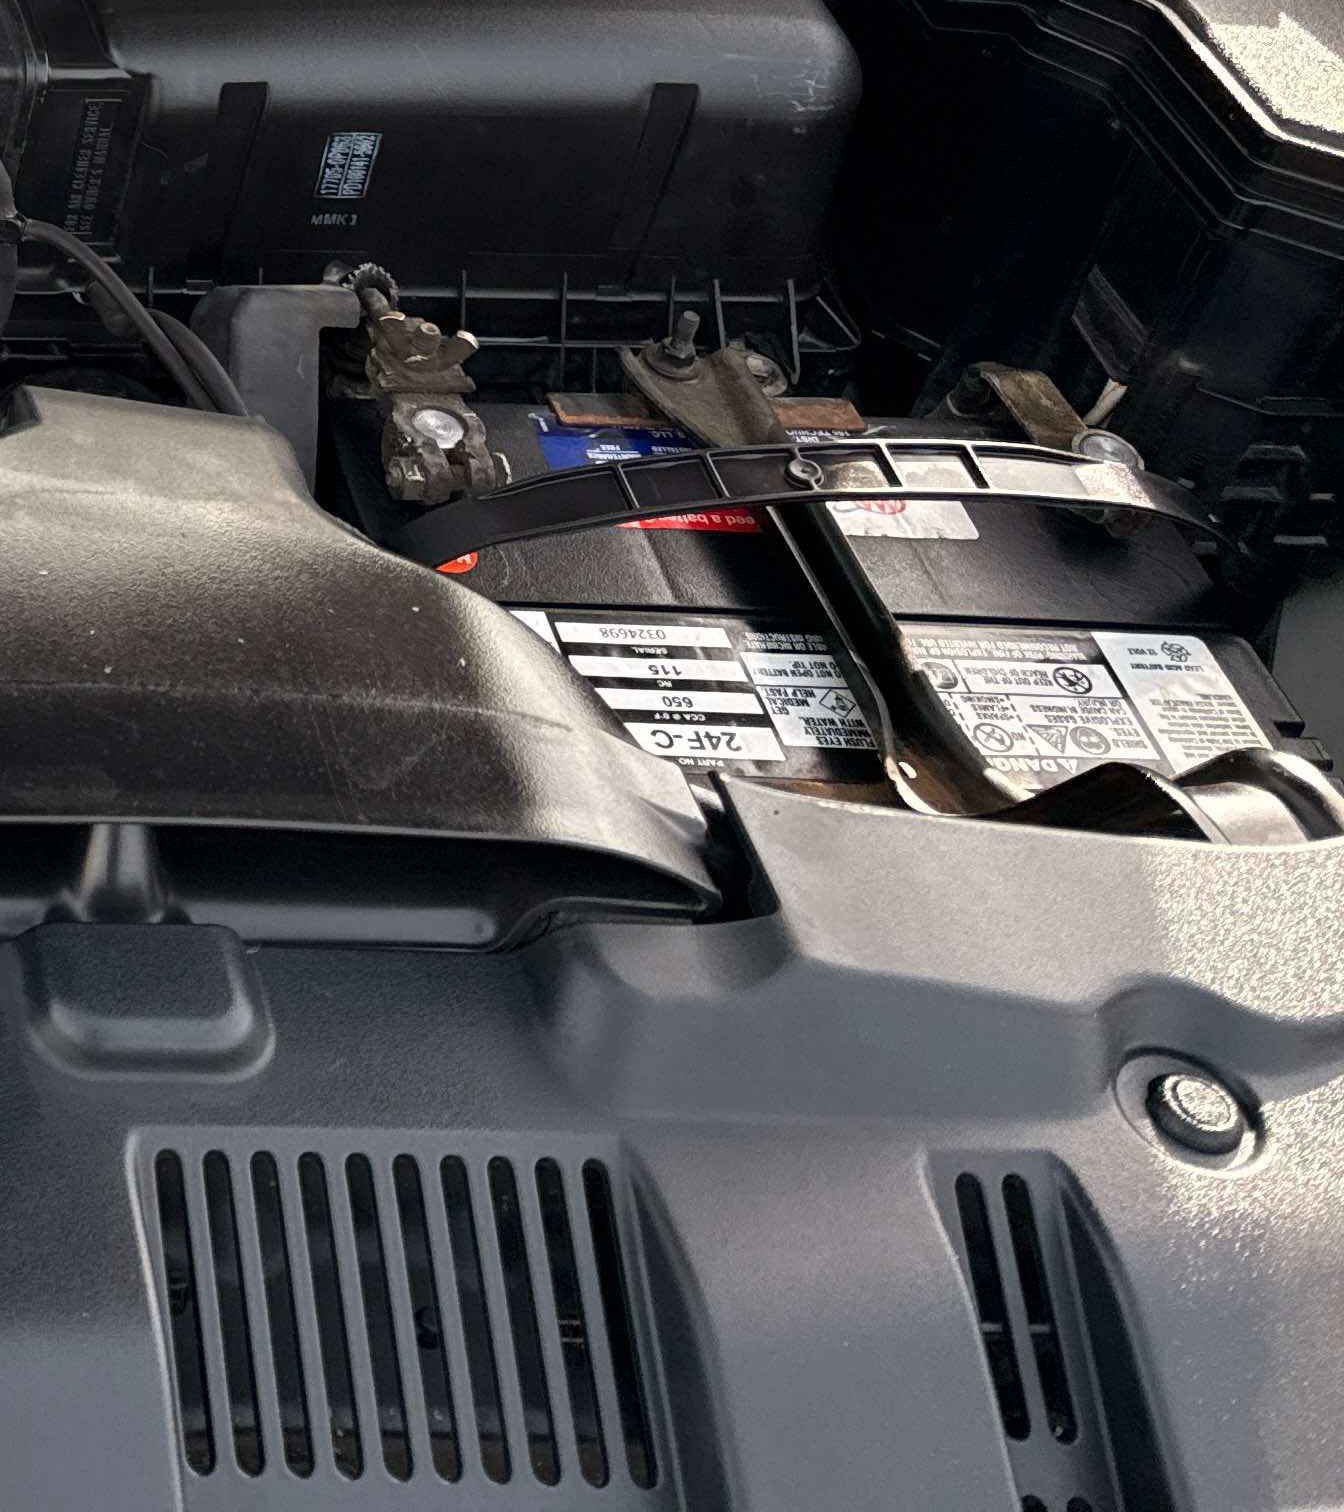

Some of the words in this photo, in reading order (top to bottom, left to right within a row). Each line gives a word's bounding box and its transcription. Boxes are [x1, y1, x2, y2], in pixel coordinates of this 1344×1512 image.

[598, 627, 667, 641] 0324698
[630, 646, 669, 655] SERIAL
[647, 664, 683, 677] 115
[808, 661, 826, 670] NOT
[790, 669, 814, 678] OPEN
[816, 670, 834, 679] NOT
[656, 679, 673, 688] RC
[791, 688, 817, 699] HELP
[661, 695, 694, 709] 650
[763, 696, 811, 708] MEDICAL
[770, 706, 790, 716] GET
[681, 712, 706, 722] CCA
[1077, 714, 1133, 725] EXPLOSIVE
[836, 718, 867, 728] WITH
[803, 726, 872, 738] IMMEDIATELY
[650, 729, 743, 752] 24F-C
[815, 735, 844, 746] EYES
[843, 737, 876, 748] FLUSH
[696, 758, 725, 767] PART
[985, 757, 1059, 772] DANG
